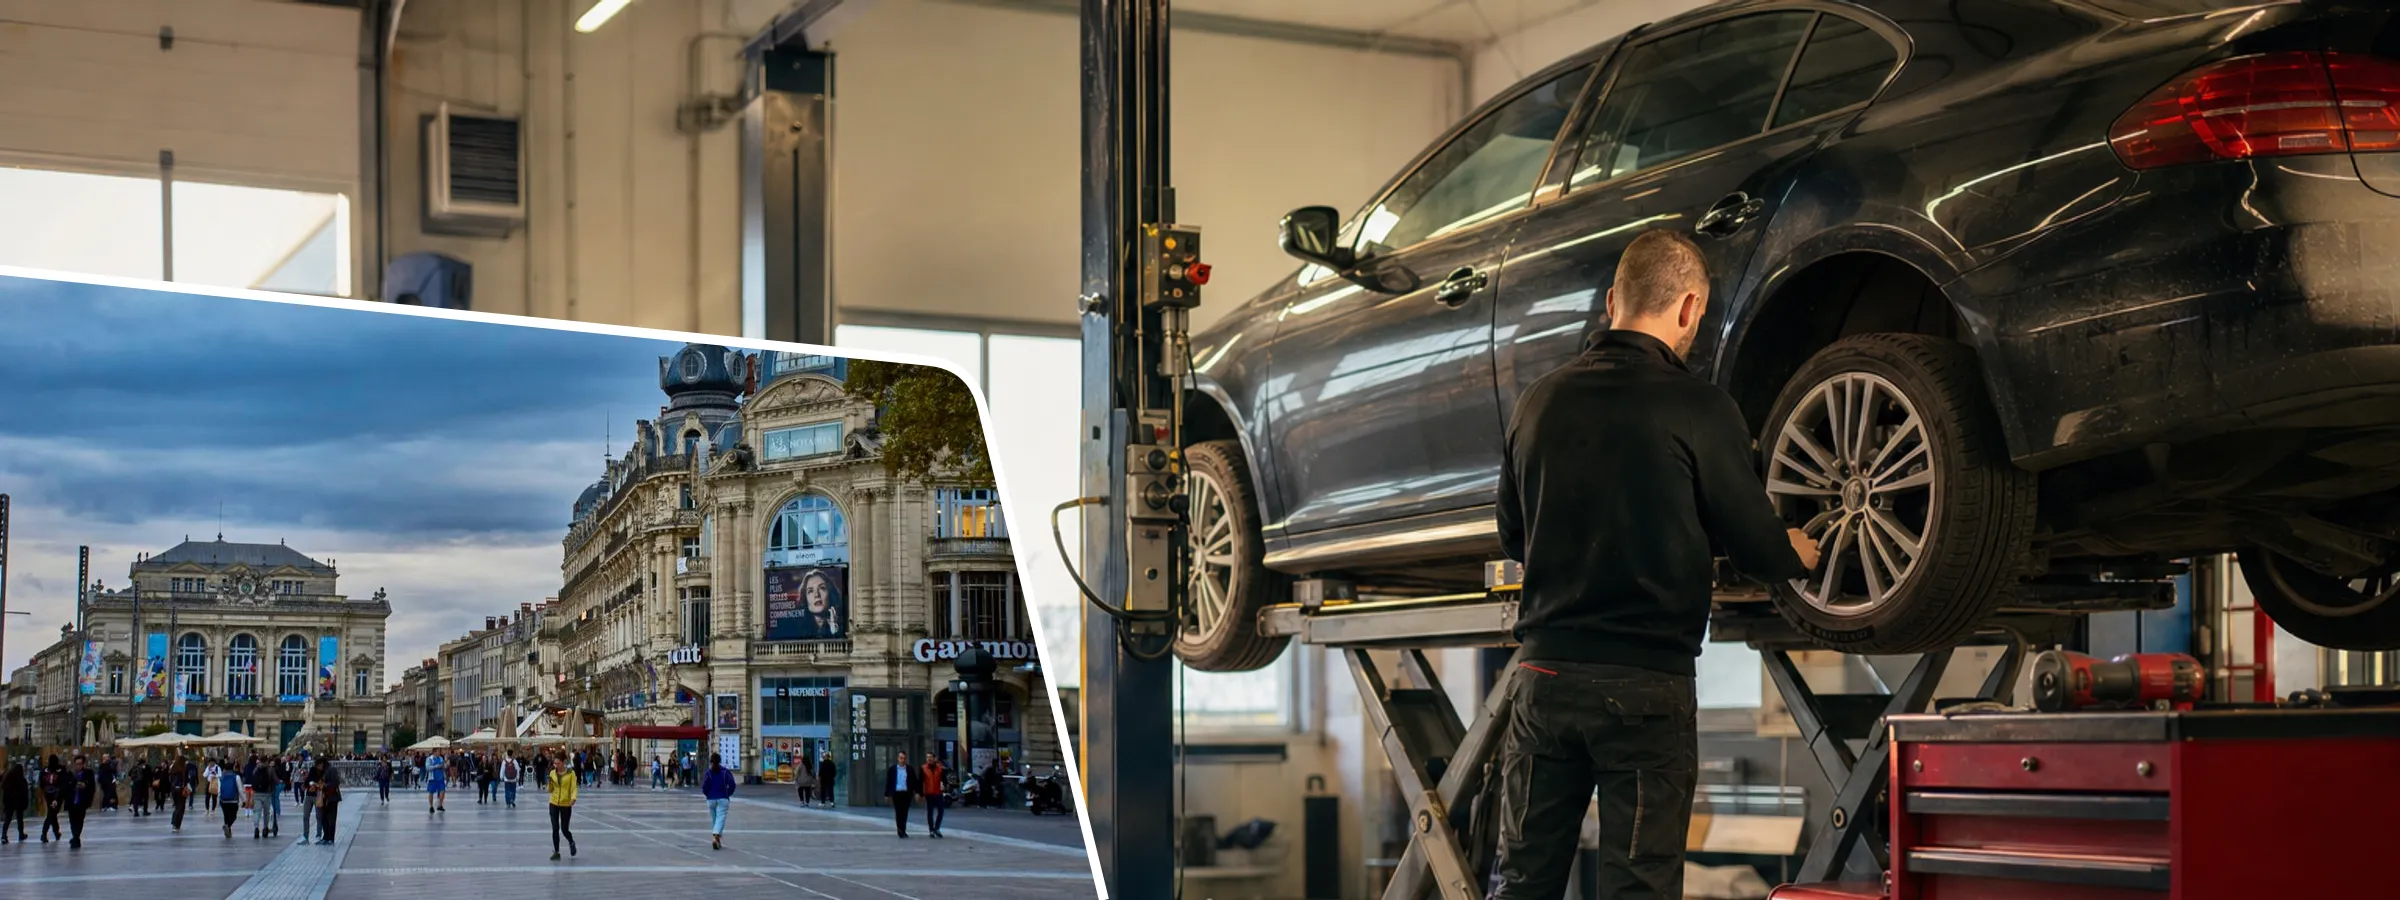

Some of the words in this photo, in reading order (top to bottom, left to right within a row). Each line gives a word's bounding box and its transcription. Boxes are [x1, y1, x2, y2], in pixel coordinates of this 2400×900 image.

[769, 576, 779, 584] LES
[769, 585, 783, 593] PLUS
[769, 593, 788, 601] BELLES
[769, 601, 796, 610] HISTOIRES
[769, 609, 805, 619] COMMENCENT
[852, 694, 867, 760] Parking
